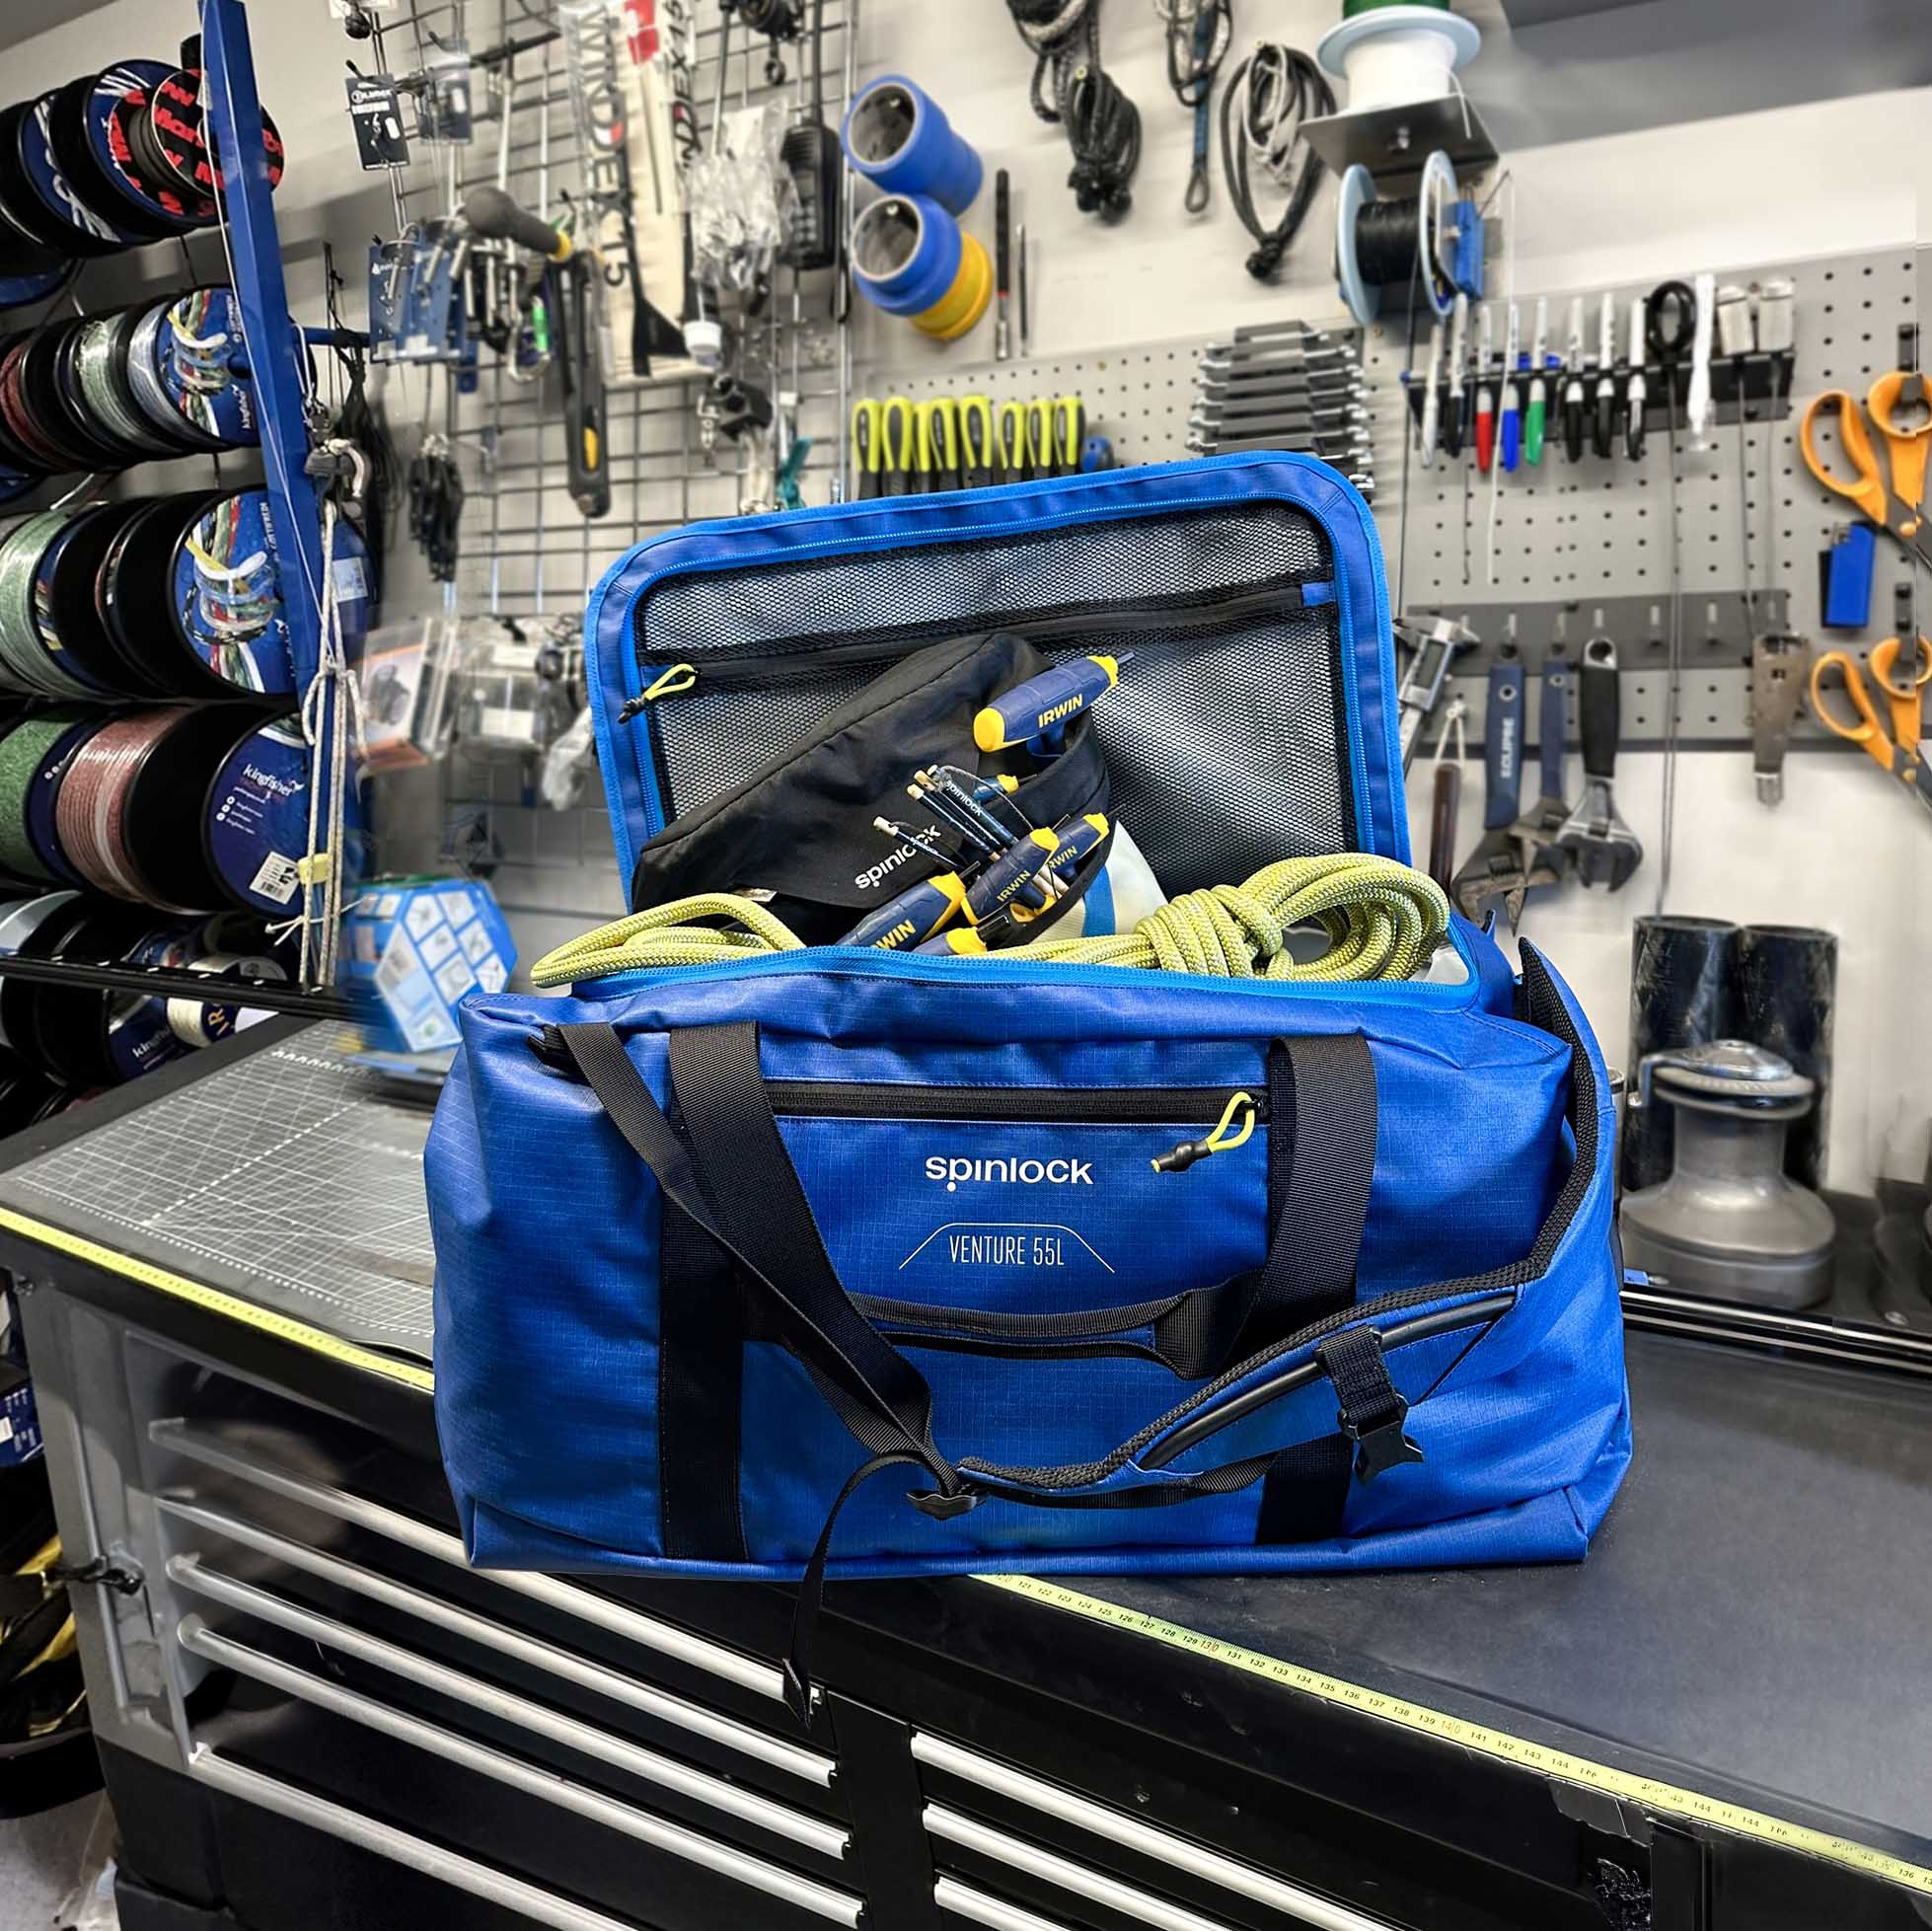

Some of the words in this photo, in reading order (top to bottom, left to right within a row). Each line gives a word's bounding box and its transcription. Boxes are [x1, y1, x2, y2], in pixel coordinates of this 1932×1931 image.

[601, 232, 632, 287] 15
[1038, 693, 1083, 728] IRWIN
[243, 764, 293, 797] kingfisher
[944, 778, 984, 817] spinlock
[855, 825, 941, 889] spinlock
[1047, 846, 1078, 869] RWIN
[997, 869, 1032, 902] IRWIN
[871, 920, 917, 949] WIN
[925, 1155, 1094, 1192] spinlock
[949, 1234, 1026, 1265] VENTURE
[1033, 1236, 1065, 1266] 55L
[1077, 1600, 1092, 1609] 124
[1098, 1607, 1113, 1616] 125
[1119, 1614, 1134, 1623] 126
[1140, 1620, 1155, 1630] 127
[1160, 1628, 1176, 1637] 128
[1183, 1635, 1199, 1645] 129
[1226, 1651, 1242, 1661] 131
[1249, 1659, 1266, 1669] 132
[1273, 1667, 1289, 1675] 133
[1297, 1674, 1312, 1684] 134
[1320, 1682, 1336, 1692] 135
[1344, 1690, 1360, 1700] 136
[1369, 1698, 1385, 1708] 137
[1393, 1706, 1410, 1717] 138
[1419, 1715, 1436, 1726] 139
[1470, 1731, 1487, 1743] 141
[1497, 1741, 1515, 1750] 142
[1524, 1749, 1541, 1760] 143
[1551, 1758, 1569, 1769] 144
[1898, 1869, 1915, 1879] 136
